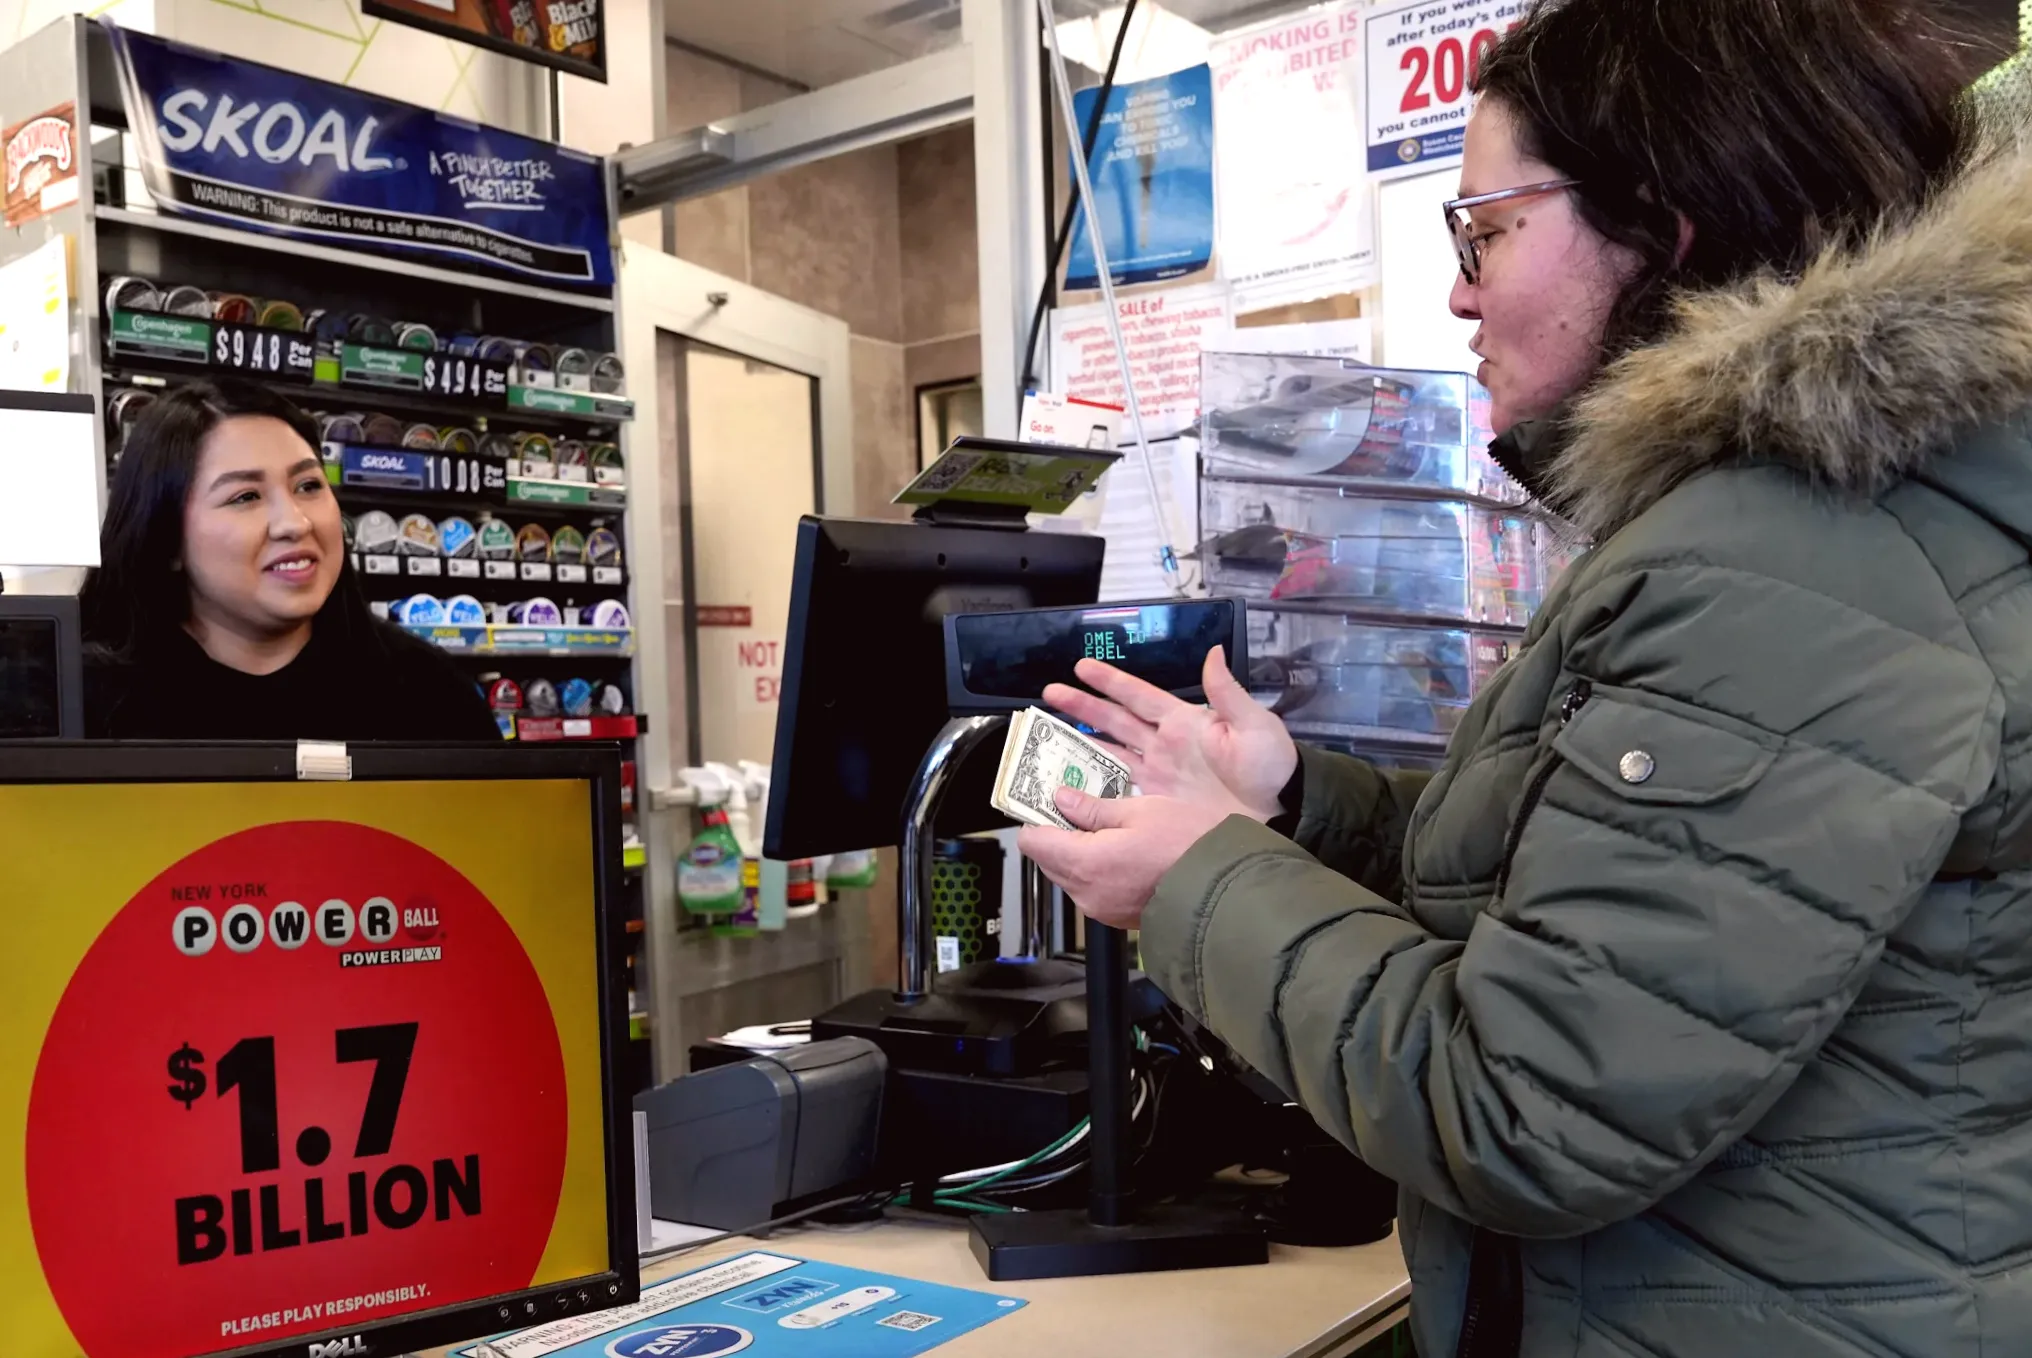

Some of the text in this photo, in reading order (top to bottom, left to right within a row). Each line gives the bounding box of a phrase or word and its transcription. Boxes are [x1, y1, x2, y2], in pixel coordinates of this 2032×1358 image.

[1339, 10, 1359, 33] IS
[1401, 12, 1413, 26] If
[1418, 6, 1447, 24] you
[1387, 30, 1425, 47] after
[1430, 12, 1490, 36] today's
[157, 88, 394, 172] SKOAL
[1377, 107, 1466, 138] you cannot
[429, 151, 443, 176] A
[448, 174, 546, 203] TOGETHER
[191, 182, 260, 213] WARNING:
[261, 199, 288, 219] This
[288, 207, 339, 227] product
[339, 211, 352, 228] is
[352, 215, 375, 233] not
[375, 220, 386, 233] a
[387, 220, 414, 235] safe
[415, 222, 475, 244] alternative
[475, 233, 488, 249] to
[1118, 299, 1148, 317] SALE
[132, 313, 193, 338] Copenhagen
[290, 340, 313, 355] Per
[287, 351, 313, 368] Can
[484, 381, 507, 394] Can
[486, 369, 505, 382] Per
[360, 452, 407, 471] SKOAL
[486, 464, 504, 478] Per
[484, 476, 506, 489] Can
[1083, 630, 1146, 647] OME TO
[738, 641, 778, 668] NOT
[171, 883, 268, 901] NEW YORK
[167, 1022, 419, 1175] $1.7
[175, 1153, 482, 1266] BILLION
[744, 1281, 817, 1306] ZYN
[221, 1283, 431, 1337] PLEASE PLAY RESPONSIBLY.
[308, 1335, 368, 1358] DELL
[539, 1324, 605, 1347] Nicotine
[633, 1330, 698, 1355] ZYN
